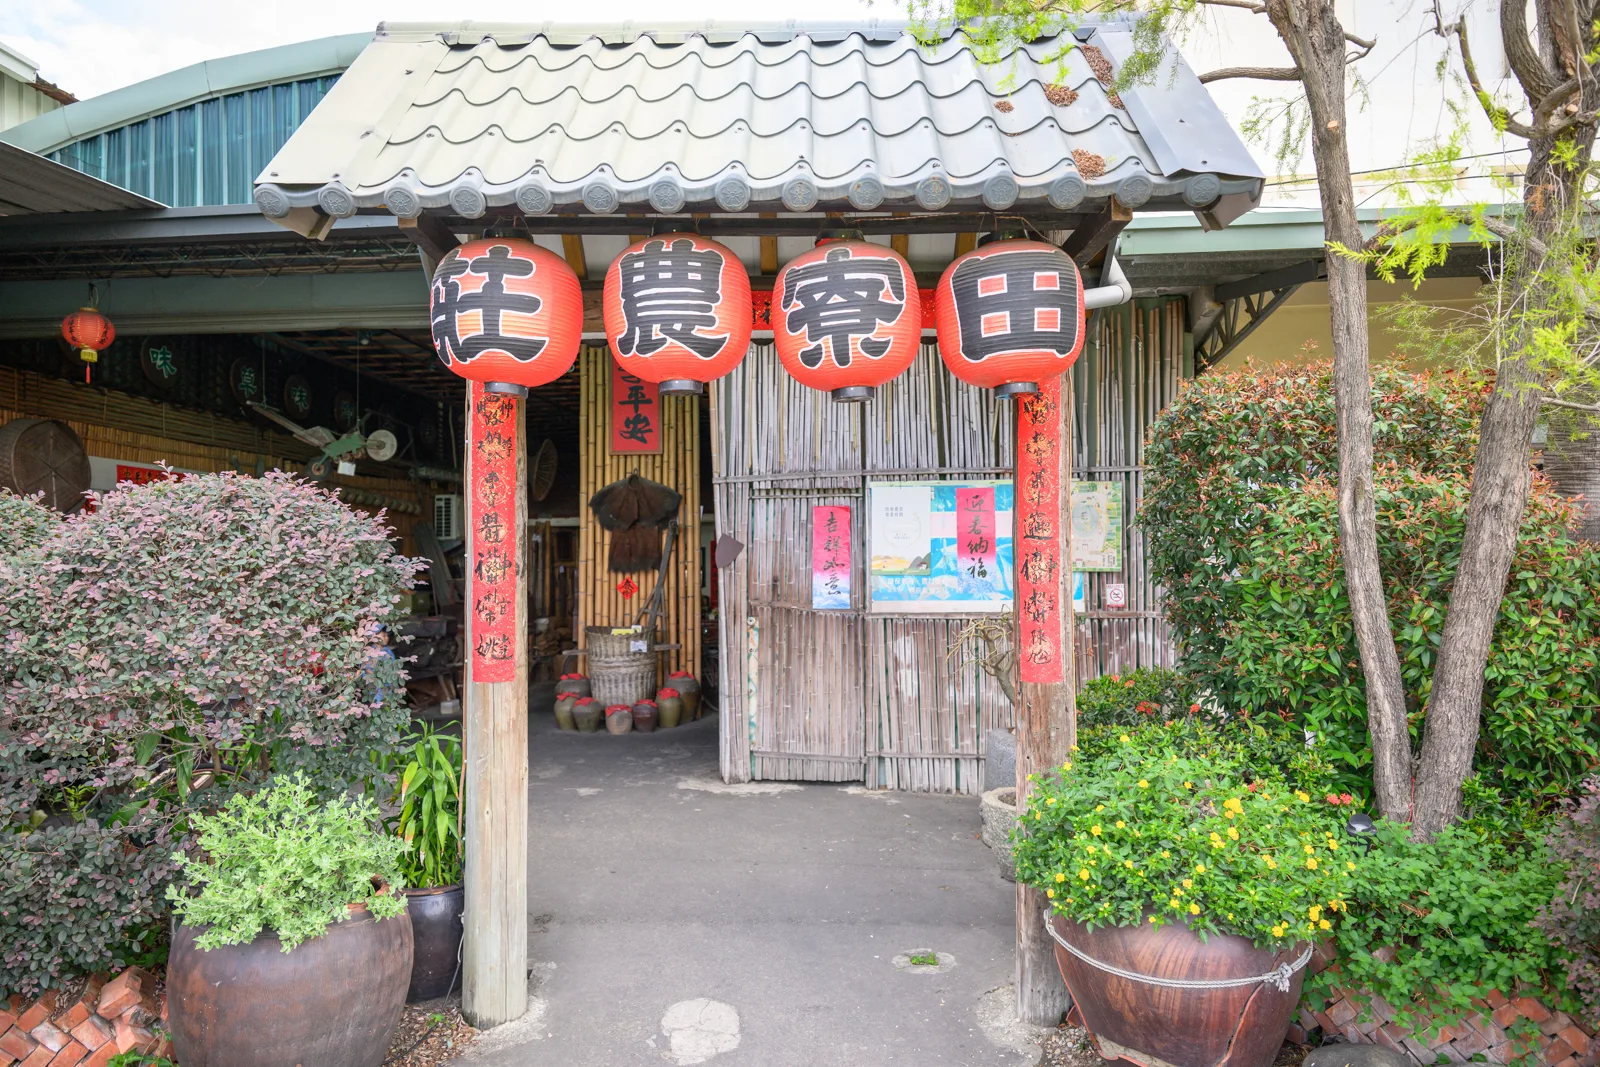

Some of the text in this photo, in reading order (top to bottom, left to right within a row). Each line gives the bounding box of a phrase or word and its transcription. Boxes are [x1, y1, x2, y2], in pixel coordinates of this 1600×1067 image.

[616, 238, 730, 359] 農
[950, 249, 1079, 363] 田
[149, 345, 178, 379] 味
[823, 510, 846, 597] 吉祥如意
[963, 494, 990, 580] 迎春納福
